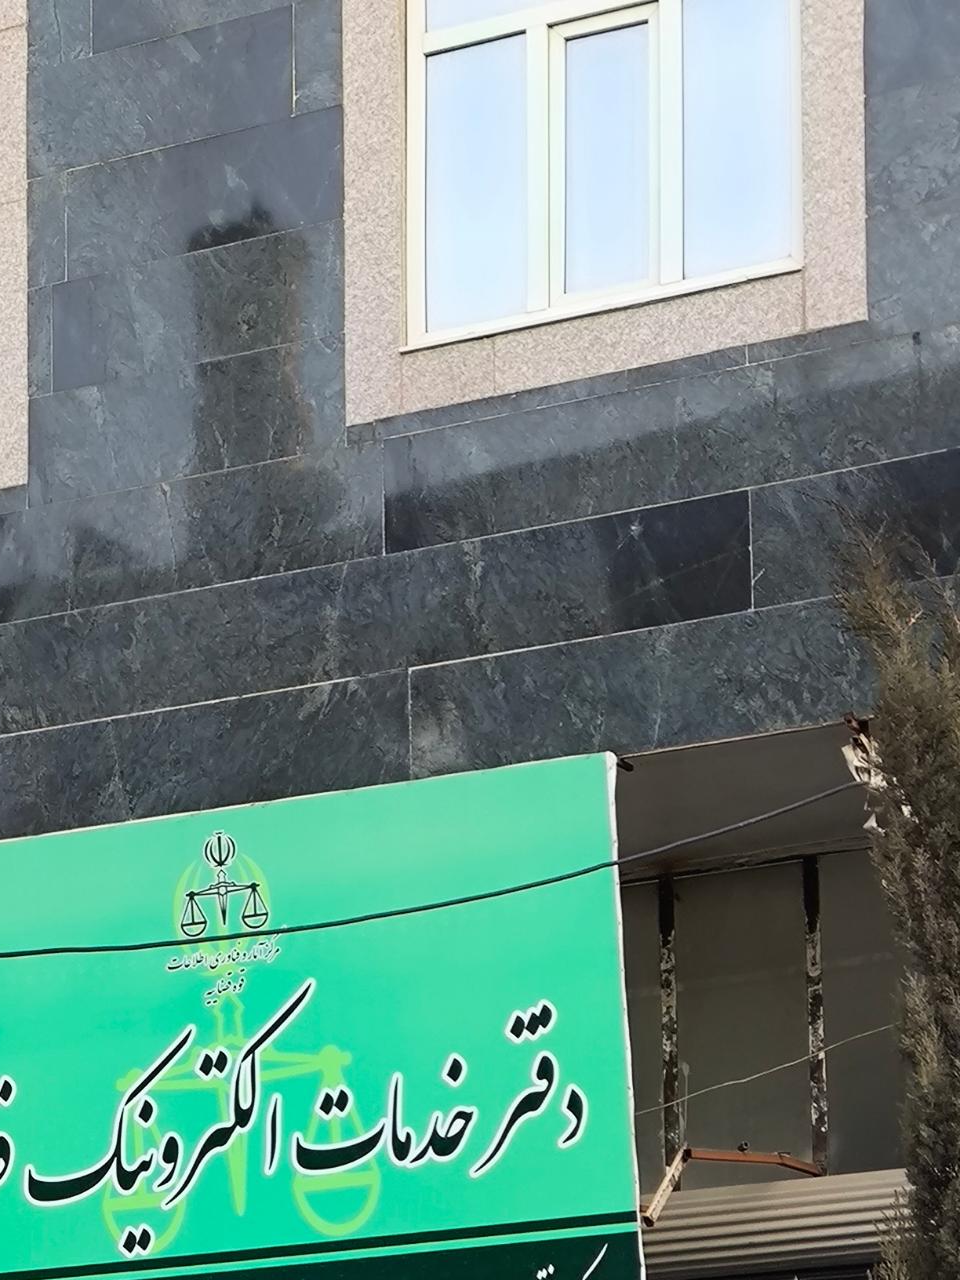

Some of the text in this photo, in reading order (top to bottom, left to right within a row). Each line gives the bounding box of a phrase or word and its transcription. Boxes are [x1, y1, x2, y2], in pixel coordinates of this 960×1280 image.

[167, 951, 208, 970] اطلاعات
[232, 968, 245, 992] قوه
[27, 981, 313, 1255] الکترونیک
[295, 1056, 475, 1171] خدمات
[472, 1003, 585, 1176] دفتر
